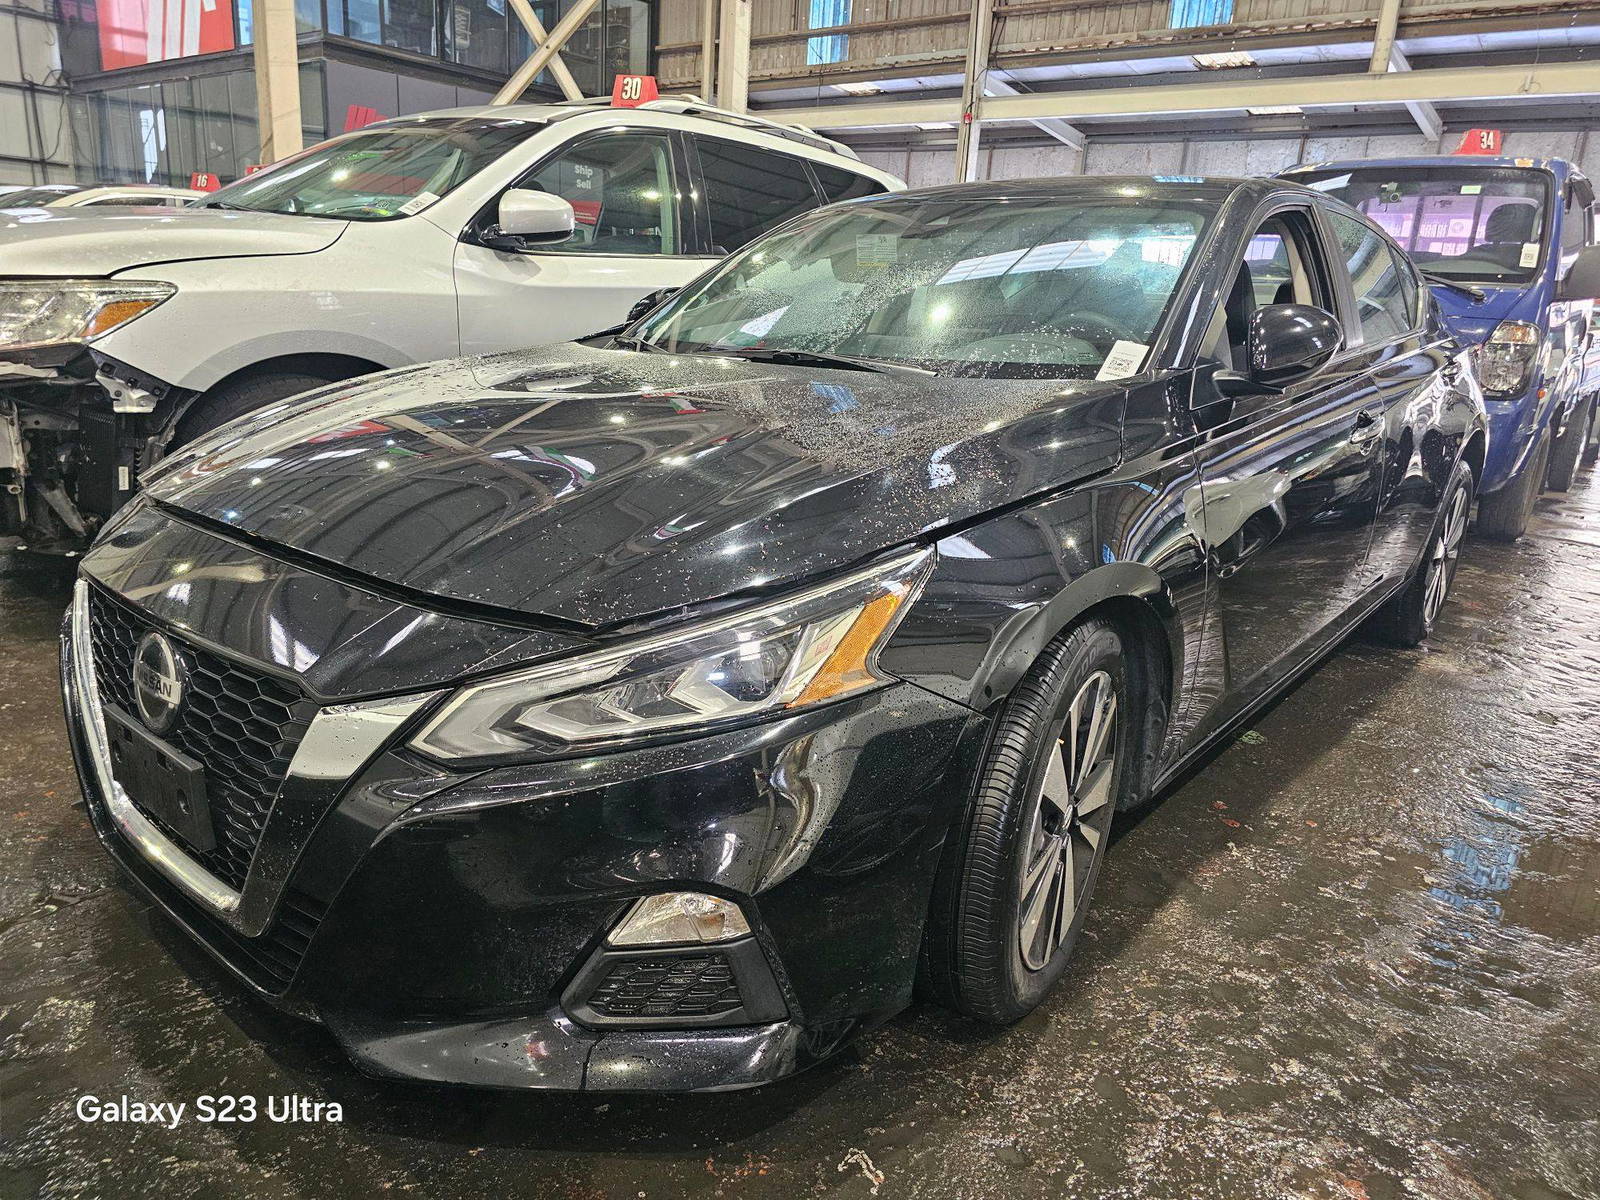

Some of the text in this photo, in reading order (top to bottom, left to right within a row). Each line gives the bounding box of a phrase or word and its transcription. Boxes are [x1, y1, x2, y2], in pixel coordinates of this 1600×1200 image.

[622, 77, 642, 100] 30
[1480, 131, 1494, 150] 34
[574, 164, 593, 178] Ship
[196, 173, 208, 188] 16
[576, 179, 592, 190] Sell
